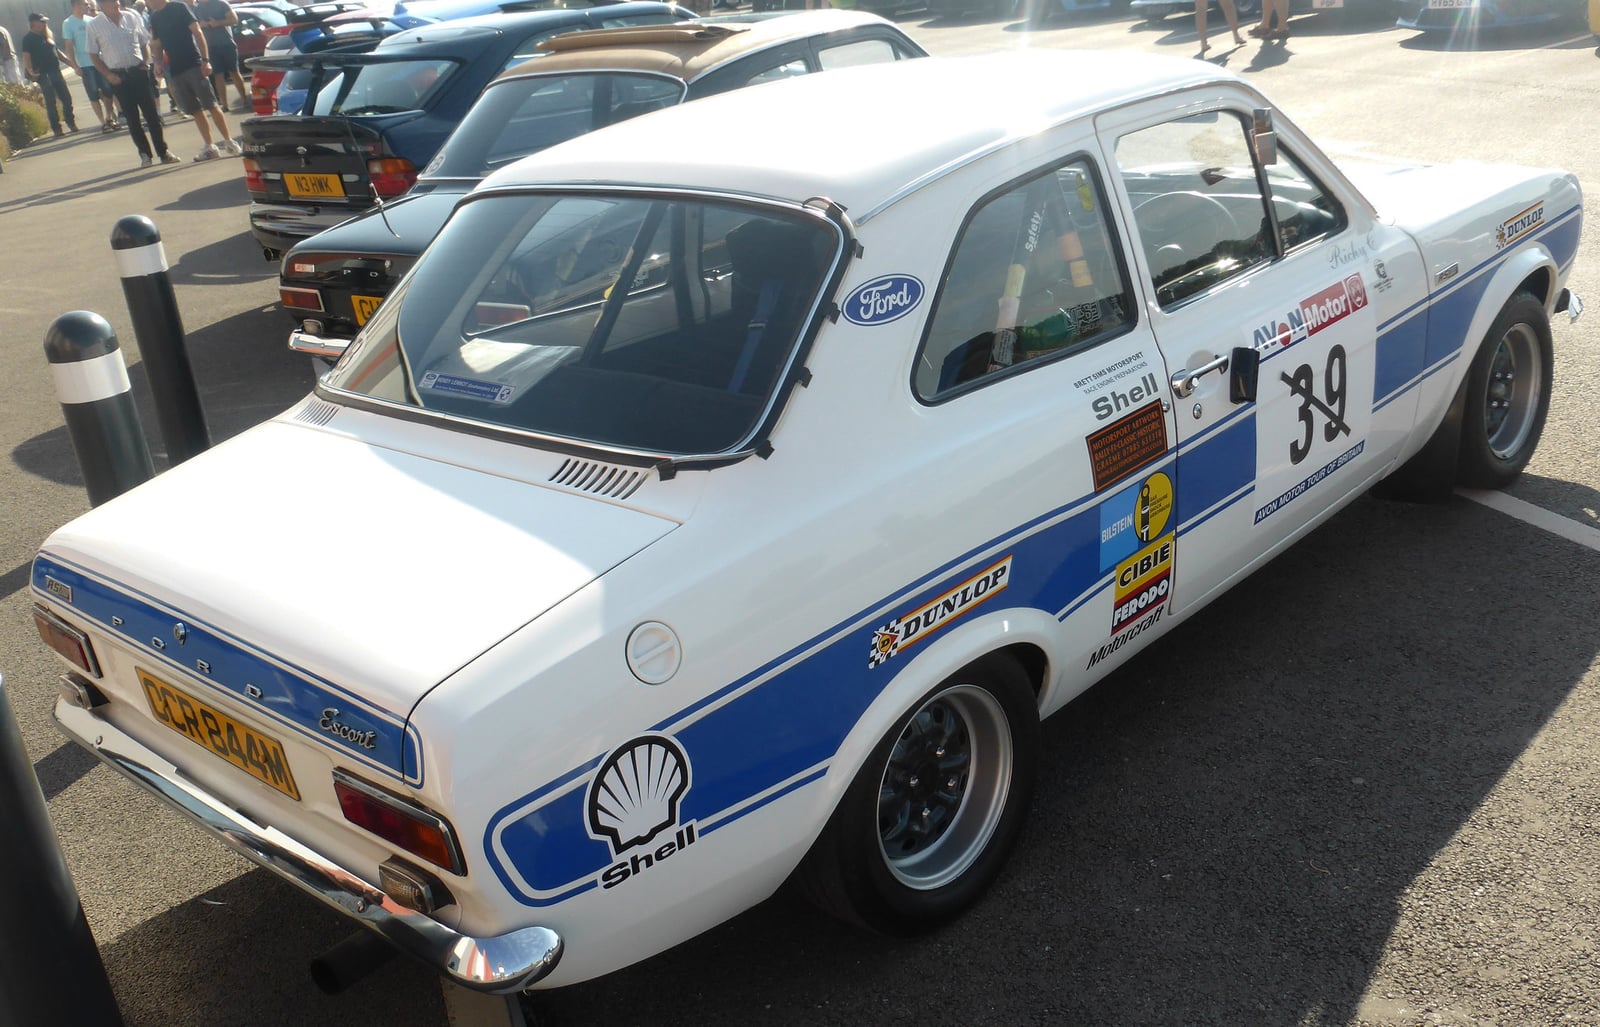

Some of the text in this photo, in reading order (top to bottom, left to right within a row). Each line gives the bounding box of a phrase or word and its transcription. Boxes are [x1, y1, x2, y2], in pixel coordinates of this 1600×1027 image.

[294, 175, 333, 193] N3 HWK
[1024, 210, 1042, 253] Safety
[1507, 207, 1544, 238] DUNLOP
[859, 280, 912, 320] Ford
[1303, 293, 1348, 331] Motor
[1073, 351, 1145, 389] BRETT SIMS MOTORSPORT
[1096, 376, 1116, 390] ENGINE
[1091, 372, 1159, 421] Shell
[1288, 343, 1348, 466] 39
[1093, 411, 1159, 451] MOTORSPORT ARTWORK
[1096, 451, 1122, 472] GRAEME
[1256, 442, 1363, 521] AVON MOTOR TOUR OF BRITAIN
[1101, 513, 1133, 544] BILSTEIN
[901, 565, 1007, 642] DUNLOP
[1112, 579, 1169, 627] FERODO
[1085, 603, 1165, 671] Motorcraft
[318, 707, 377, 750] Escort
[601, 823, 696, 890] Shell
